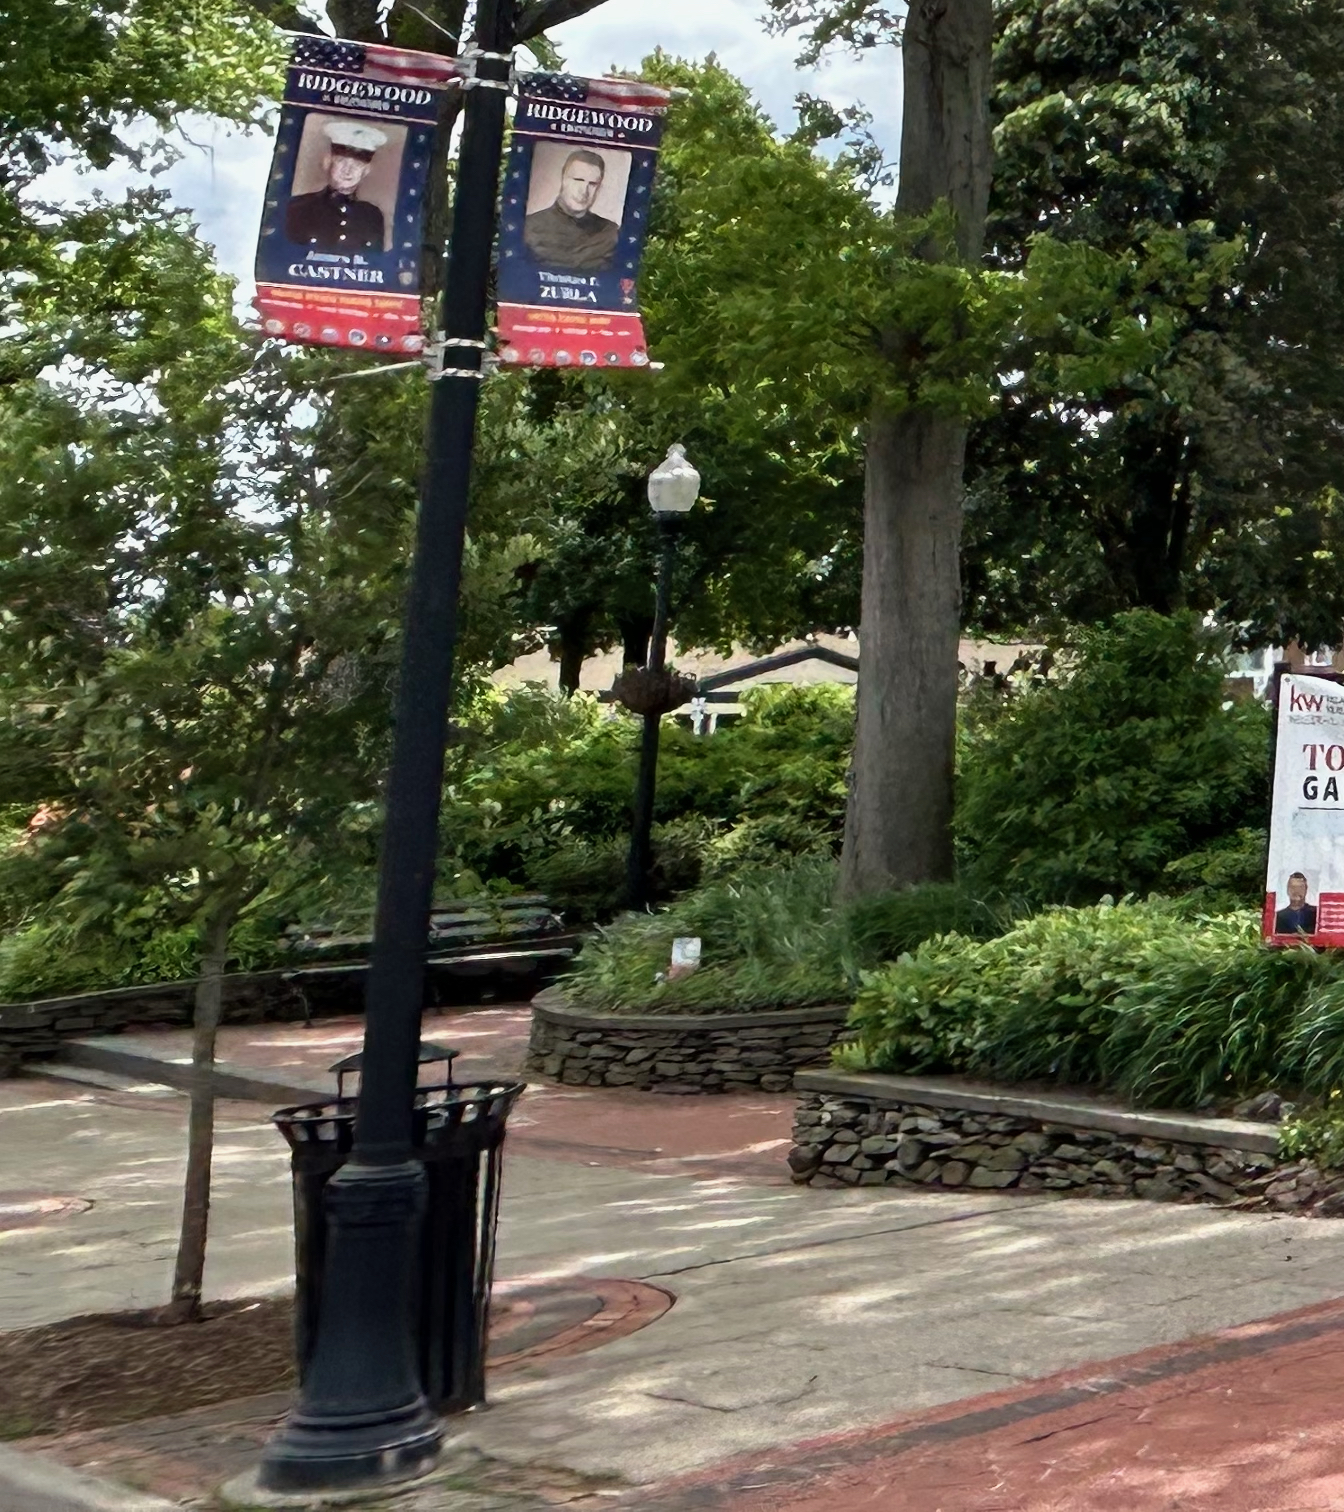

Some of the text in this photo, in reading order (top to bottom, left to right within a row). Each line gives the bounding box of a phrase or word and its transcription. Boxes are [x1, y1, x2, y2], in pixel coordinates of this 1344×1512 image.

[297, 72, 432, 105] RIDGEWOOD
[526, 102, 653, 132] RIDGEWOOD
[288, 263, 384, 284] CASTNER
